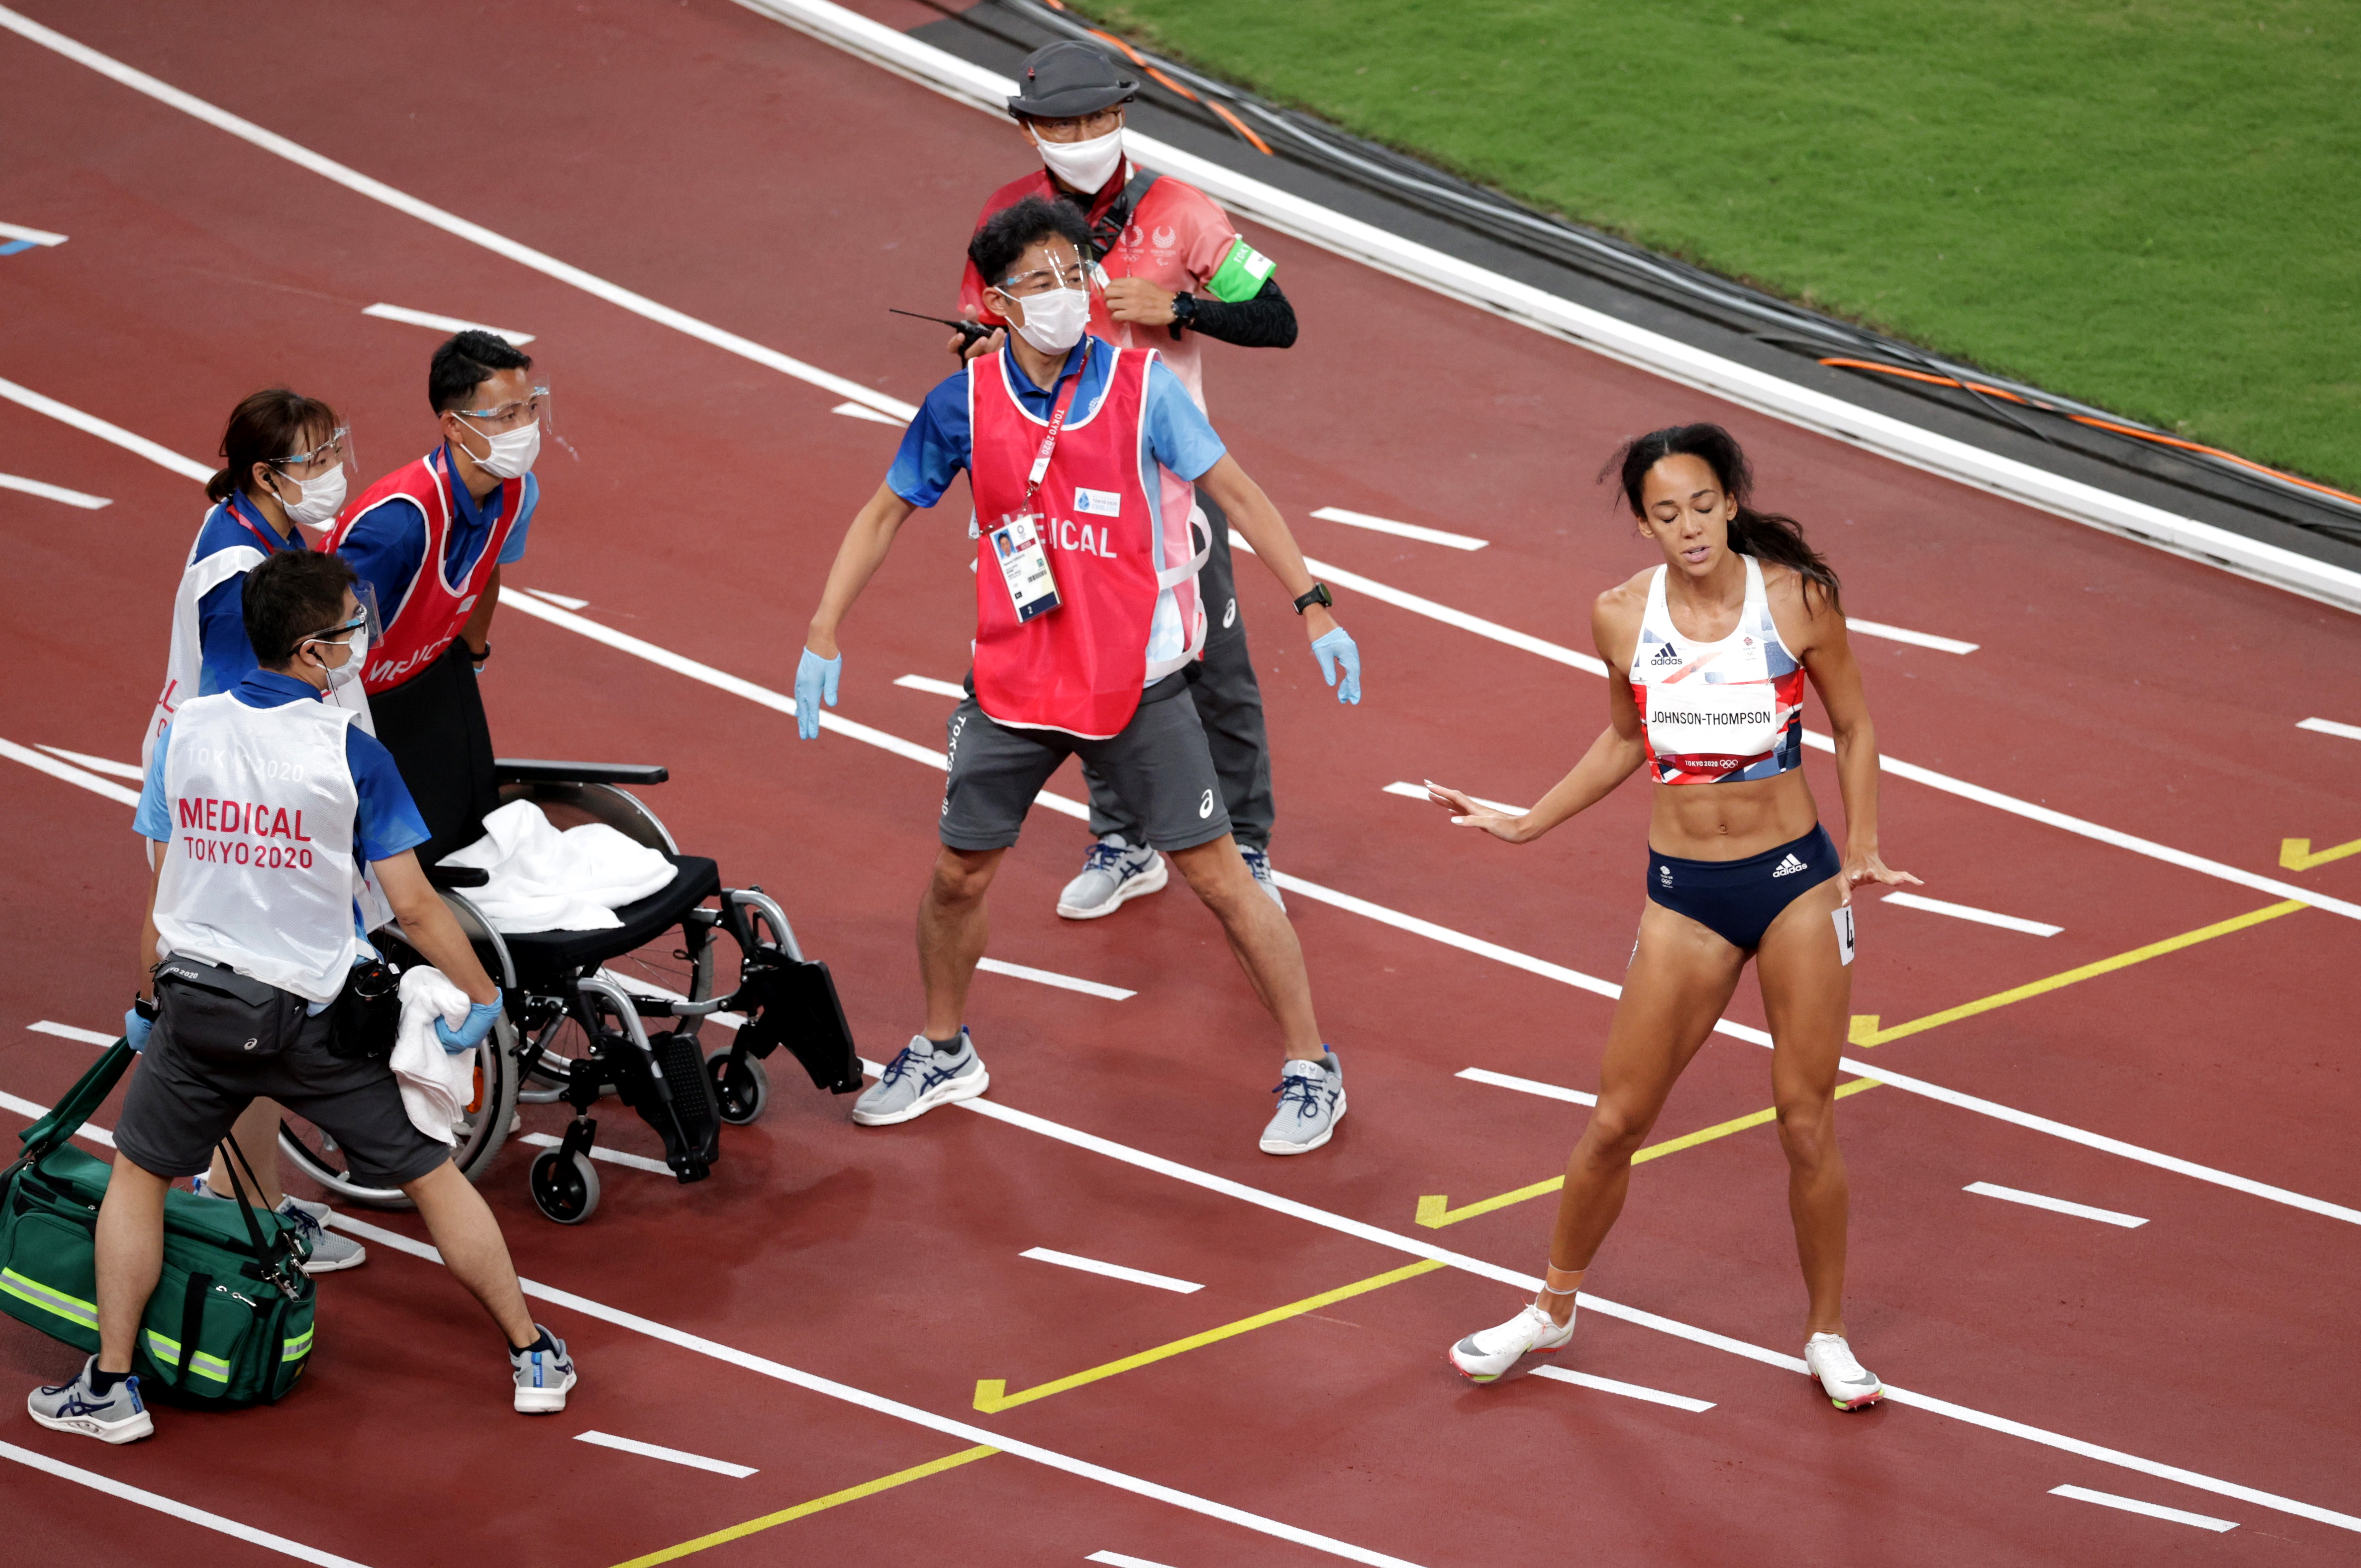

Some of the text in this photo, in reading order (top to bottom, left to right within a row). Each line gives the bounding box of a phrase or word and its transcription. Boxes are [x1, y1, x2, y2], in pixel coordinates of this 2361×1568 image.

[1041, 409, 1065, 455] TOKYO 2020
[1002, 512, 1117, 558] EICAL
[1027, 606, 1033, 614] 2
[1651, 657, 1682, 665] adidas
[1652, 711, 1770, 725] JOHNSON-THOMPSON
[947, 716, 967, 772] TOKYO
[179, 798, 311, 842] MEDICAL
[184, 837, 312, 868] TOKYO 2020
[1772, 863, 1808, 878] adidas
[179, 969, 199, 979] 2020
